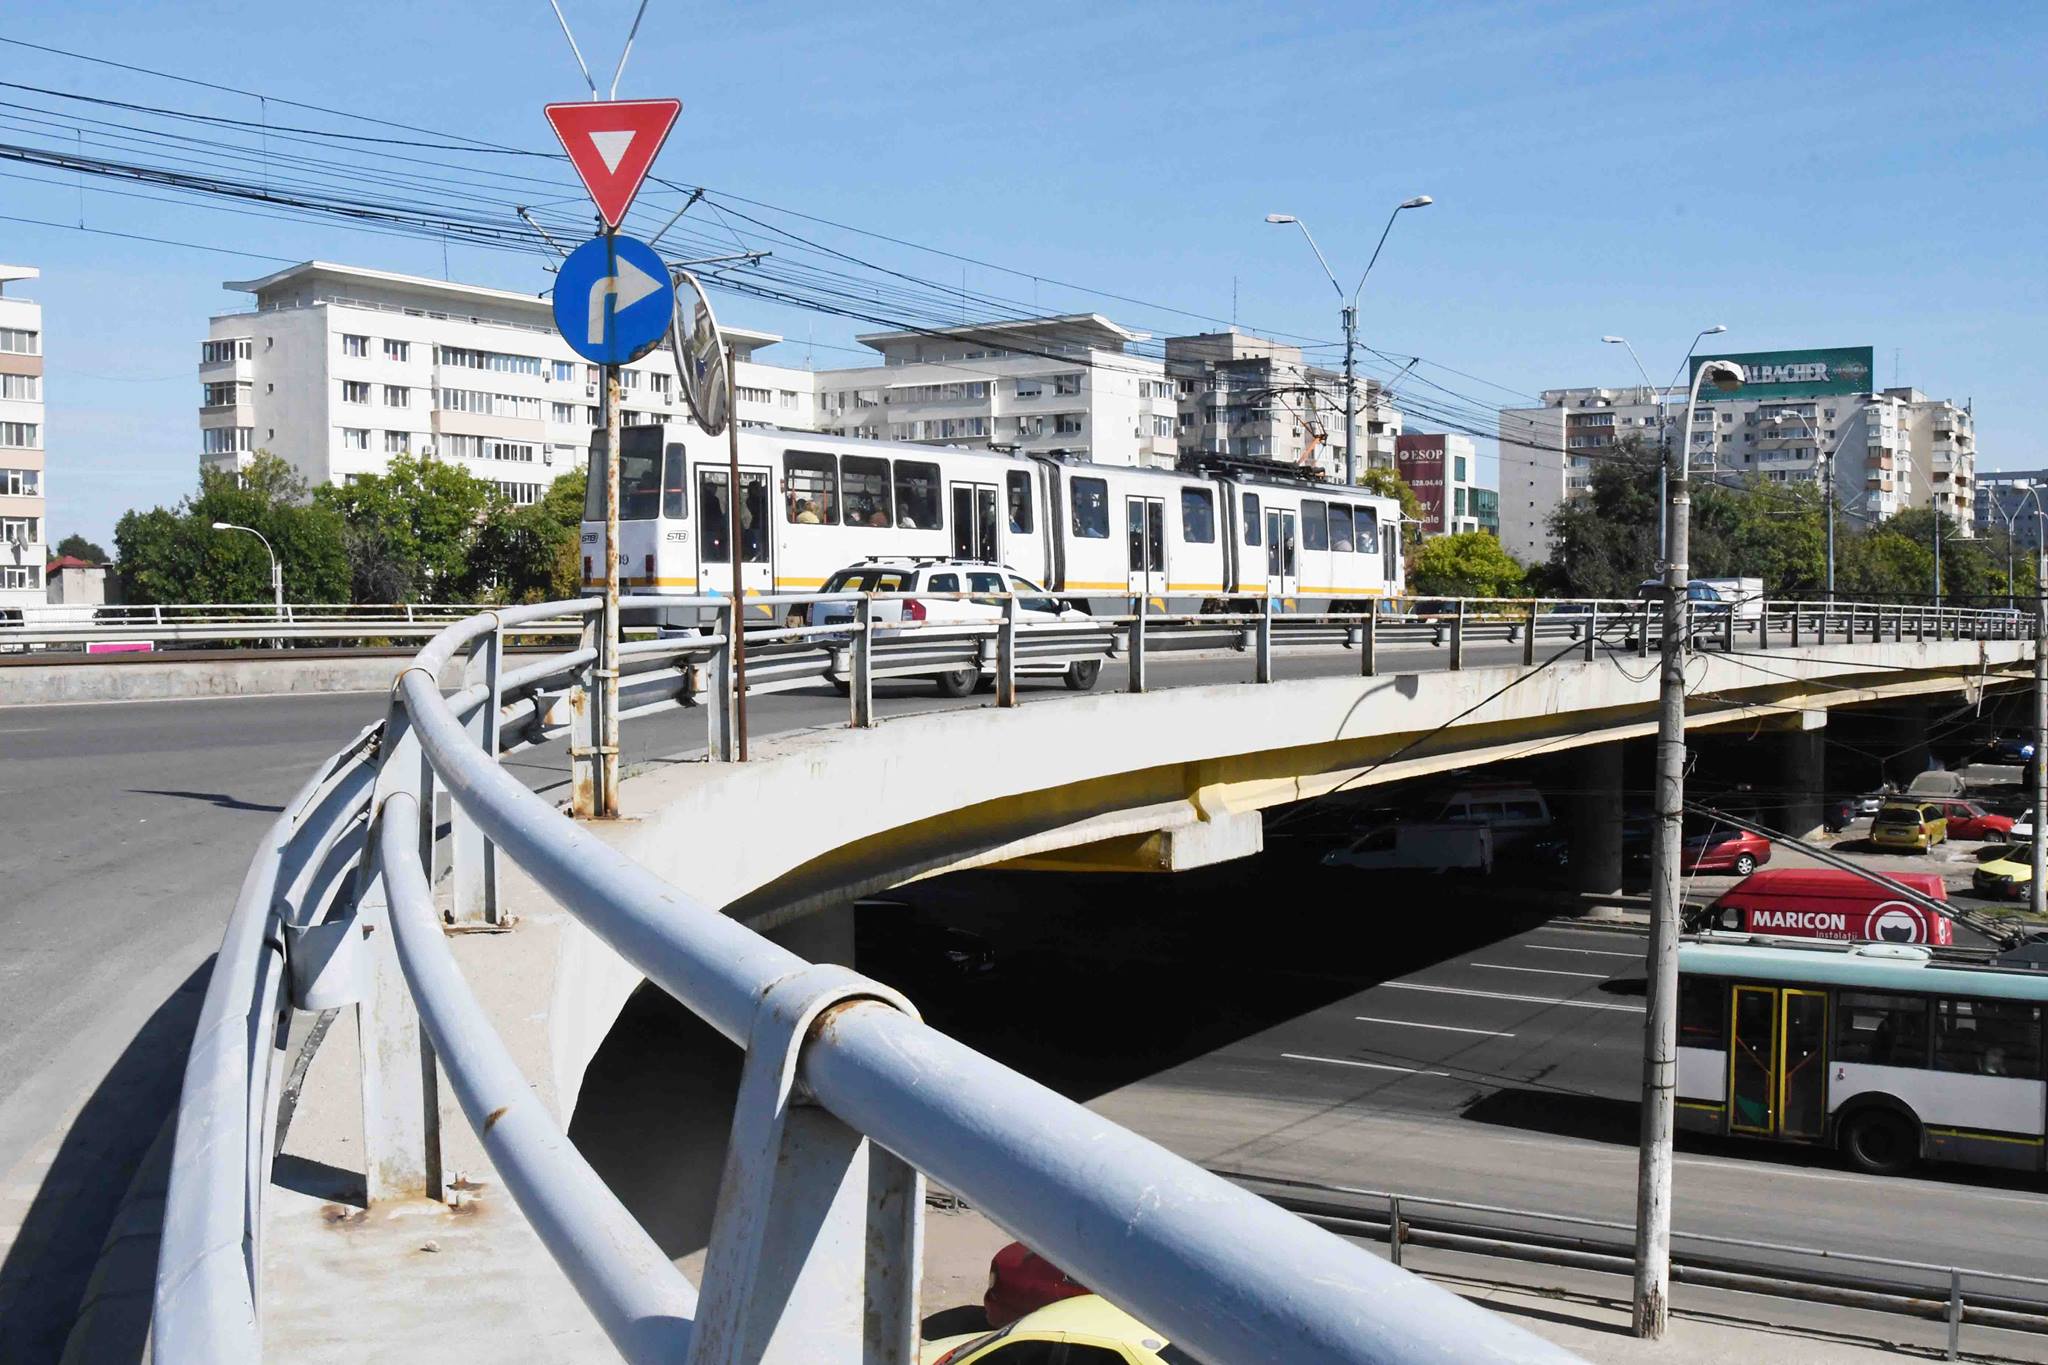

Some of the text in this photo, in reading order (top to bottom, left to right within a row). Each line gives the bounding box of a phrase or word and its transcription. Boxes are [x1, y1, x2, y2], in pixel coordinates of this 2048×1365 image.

[1411, 449, 1444, 460] ESOP
[582, 533, 597, 543] STB
[666, 532, 687, 541] STB
[1752, 910, 1846, 930] MARICON
